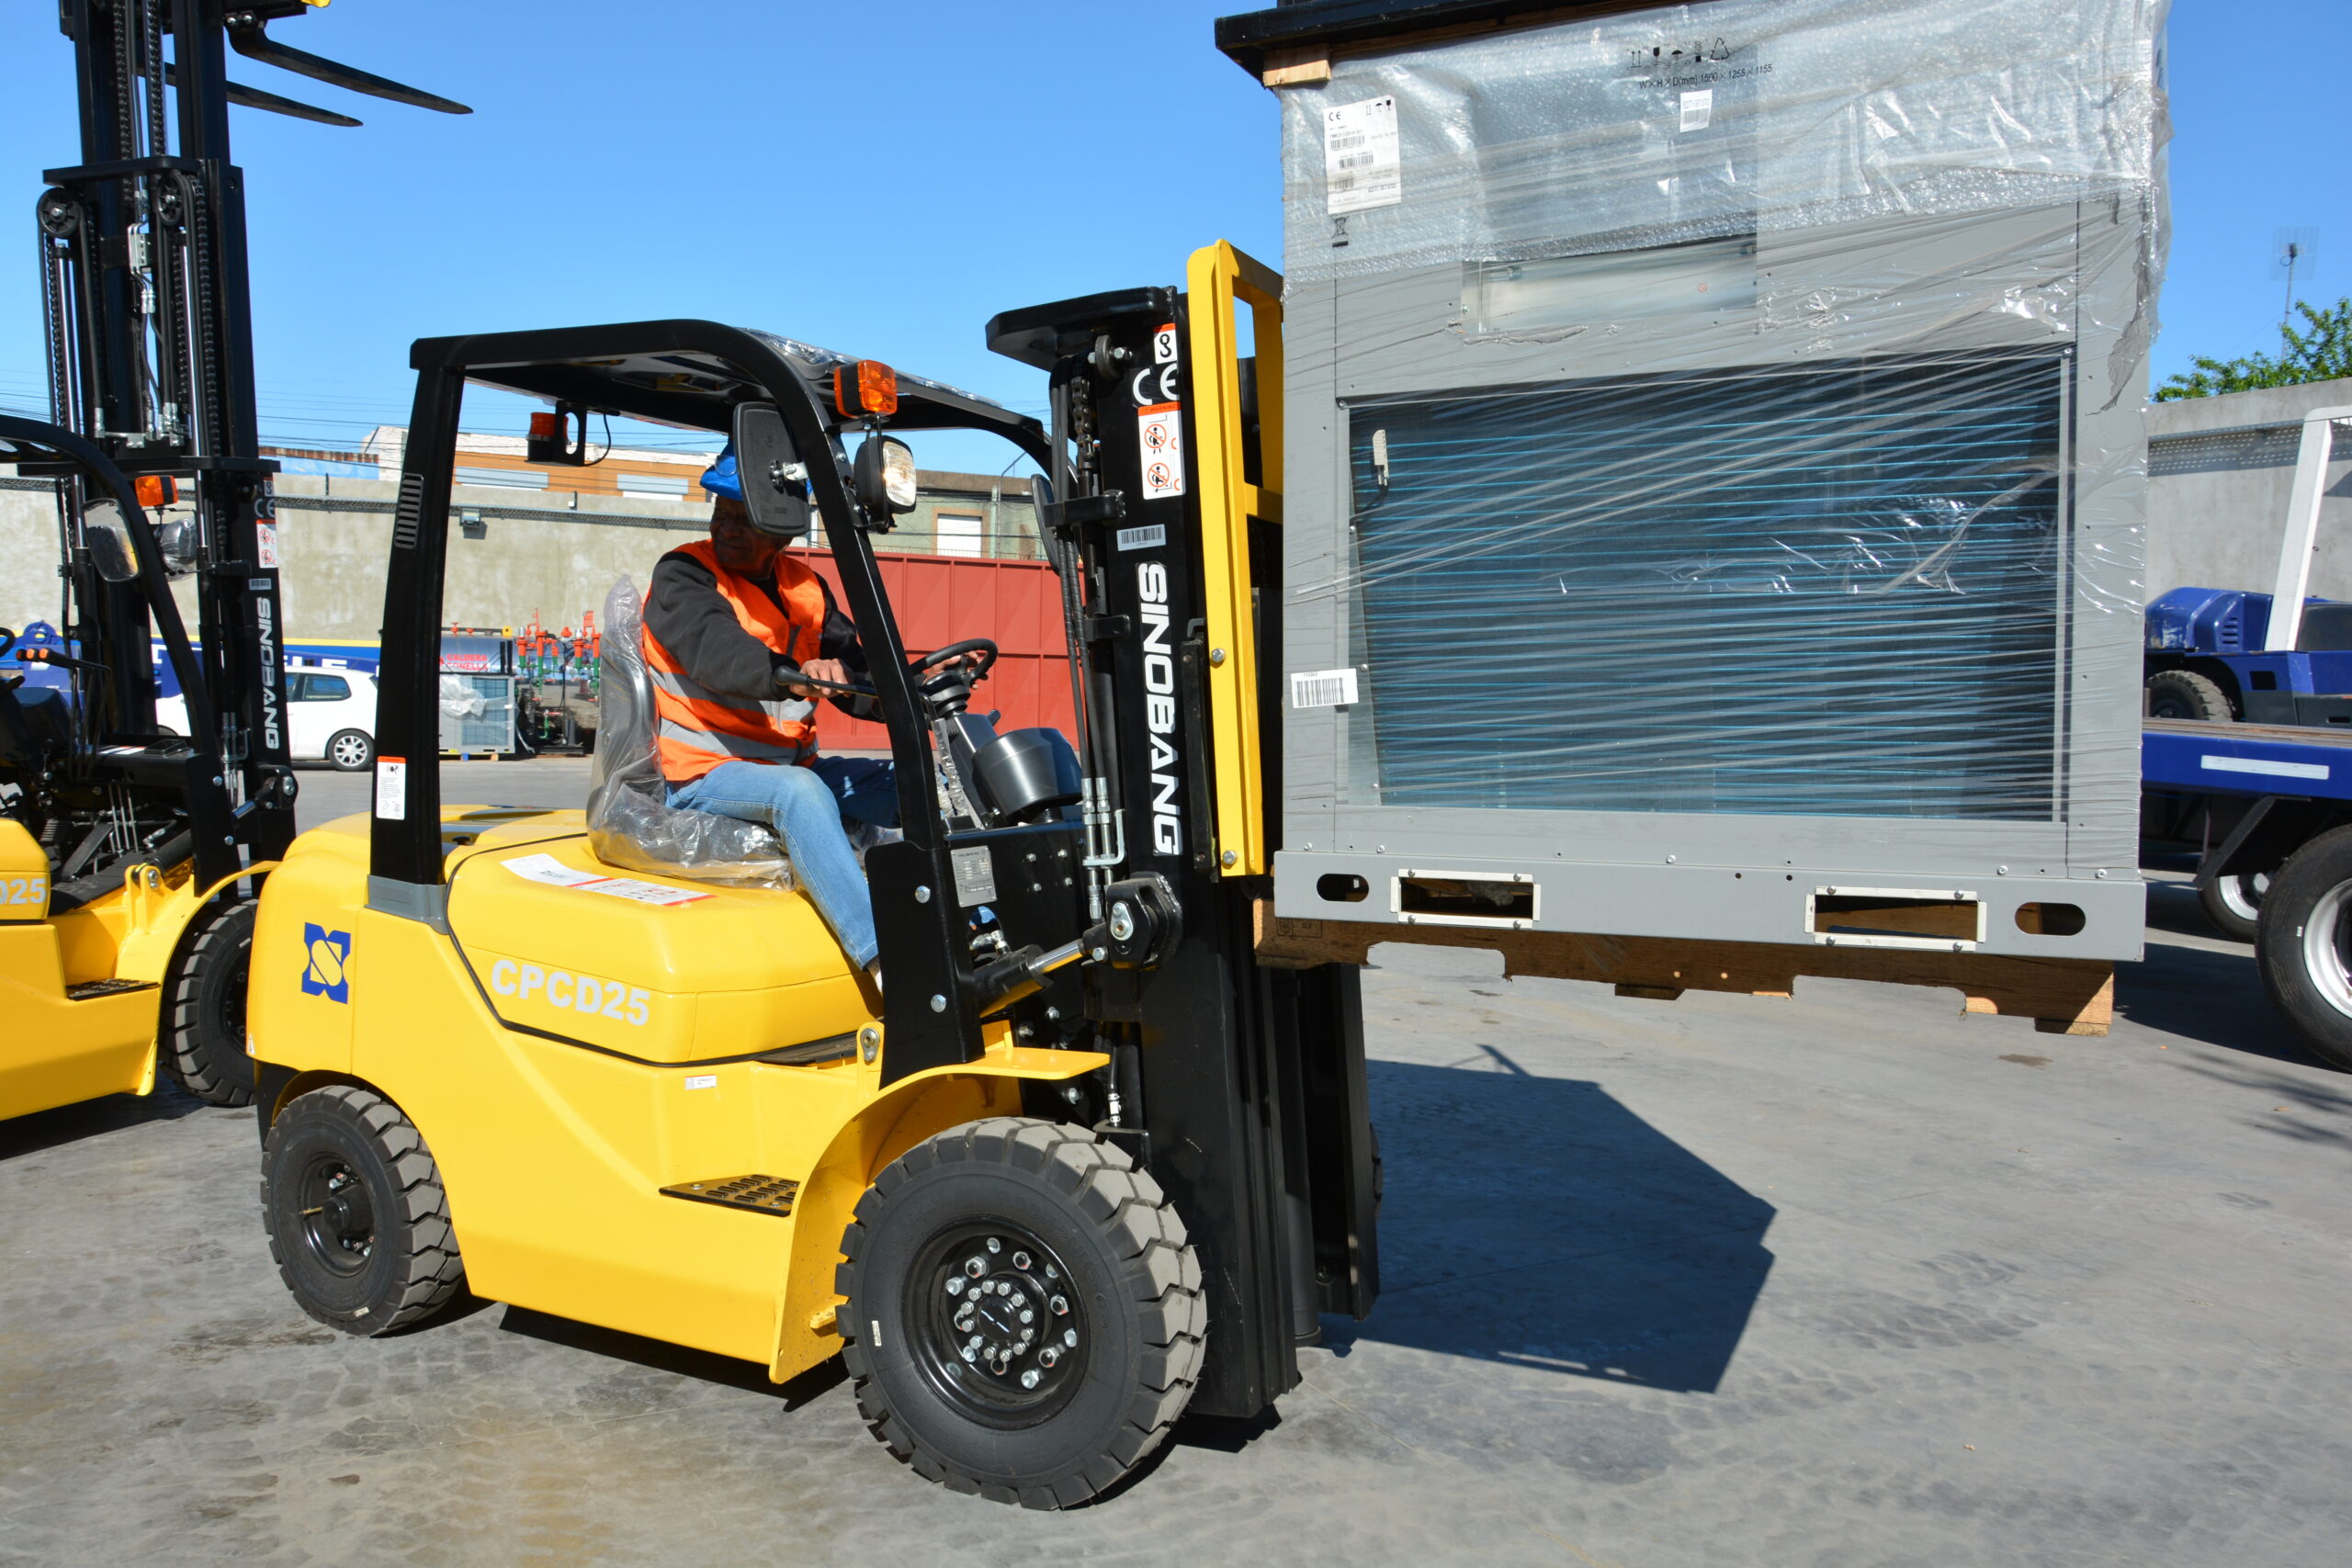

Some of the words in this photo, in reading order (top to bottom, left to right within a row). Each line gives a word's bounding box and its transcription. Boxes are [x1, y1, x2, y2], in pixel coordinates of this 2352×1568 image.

[1329, 110, 1341, 121] CE
[1133, 362, 1180, 406] CE
[256, 598, 279, 750] SINOBANG
[1138, 563, 1182, 855] SINOBANG
[491, 960, 650, 1026] CPCD25
